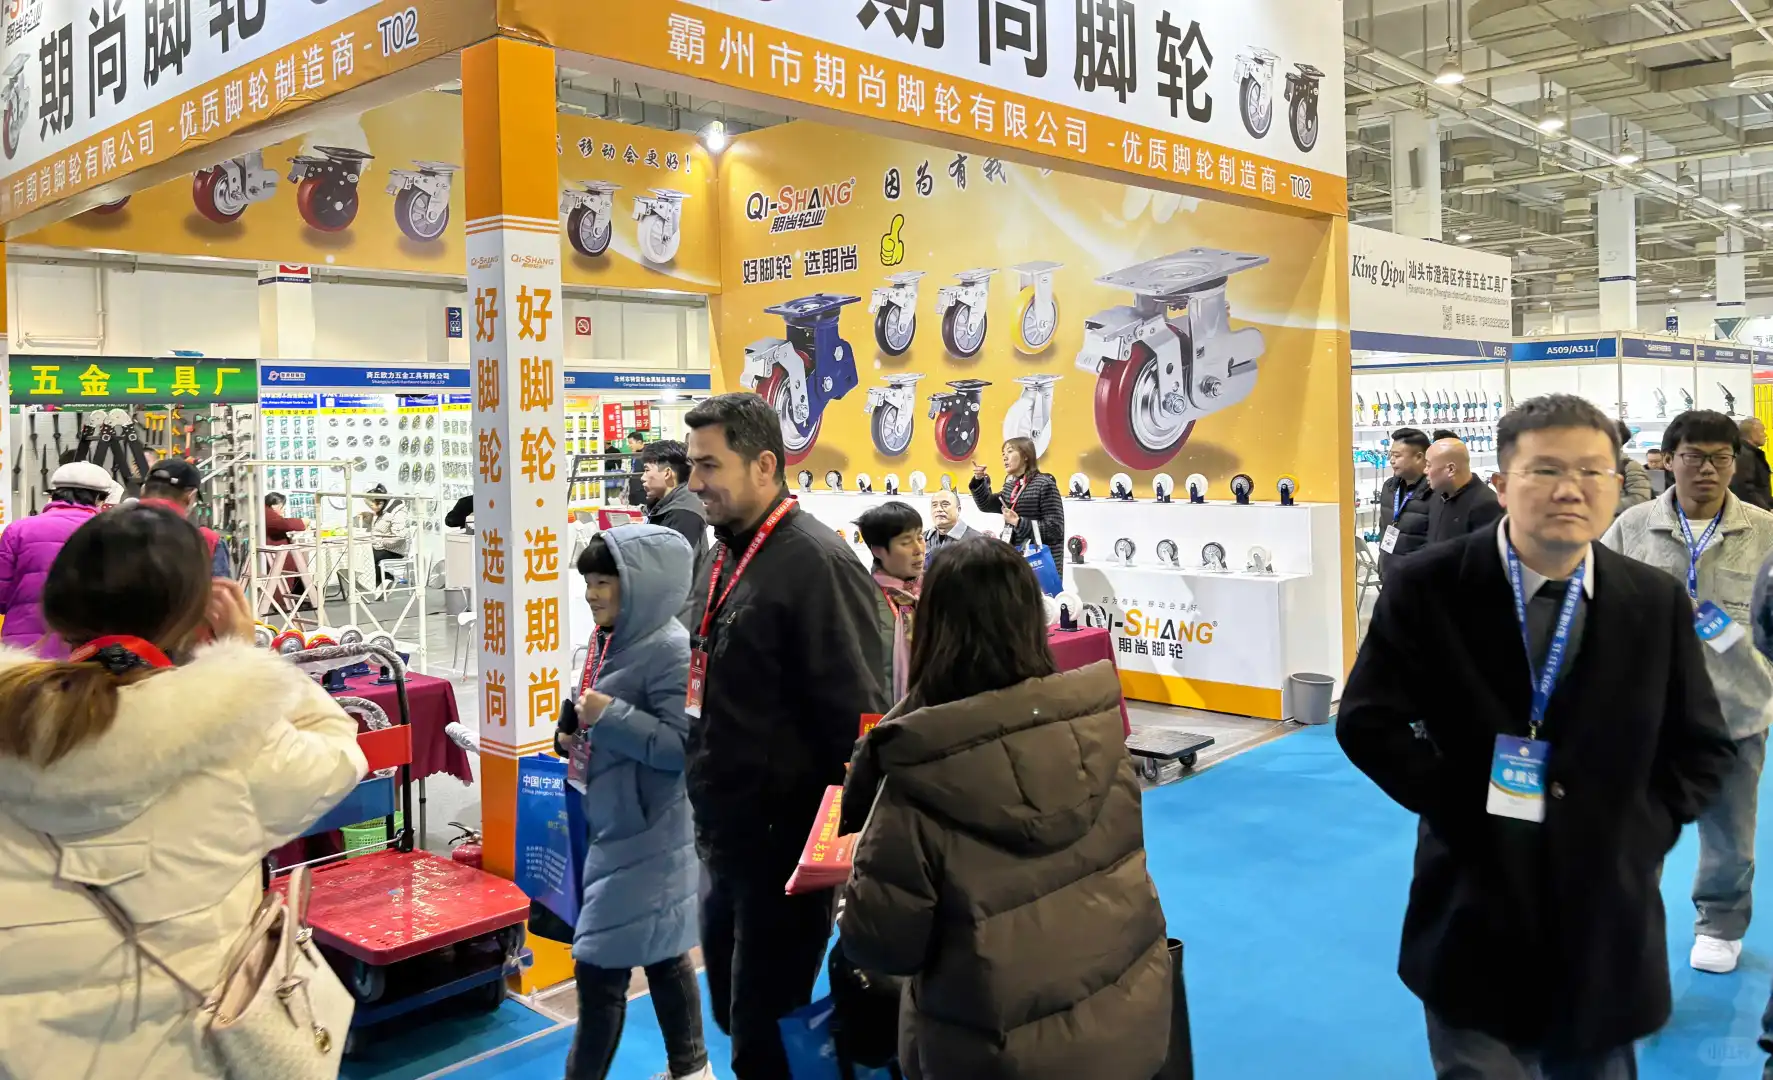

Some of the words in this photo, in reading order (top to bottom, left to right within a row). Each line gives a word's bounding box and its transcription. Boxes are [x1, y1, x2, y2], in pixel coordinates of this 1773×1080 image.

[667, 12, 1088, 154] 霸州市期尚脚轮有限公司
[769, 210, 827, 234] 期尚轮业
[742, 252, 793, 285] 好脚轮
[803, 244, 859, 277] 选期尚
[1351, 254, 1378, 285] King
[1380, 259, 1406, 288] Qipu
[1546, 344, 1595, 355] A509/A511
[9, 364, 242, 397] 五金工具厂
[1118, 637, 1184, 660] 期尚脚轮
